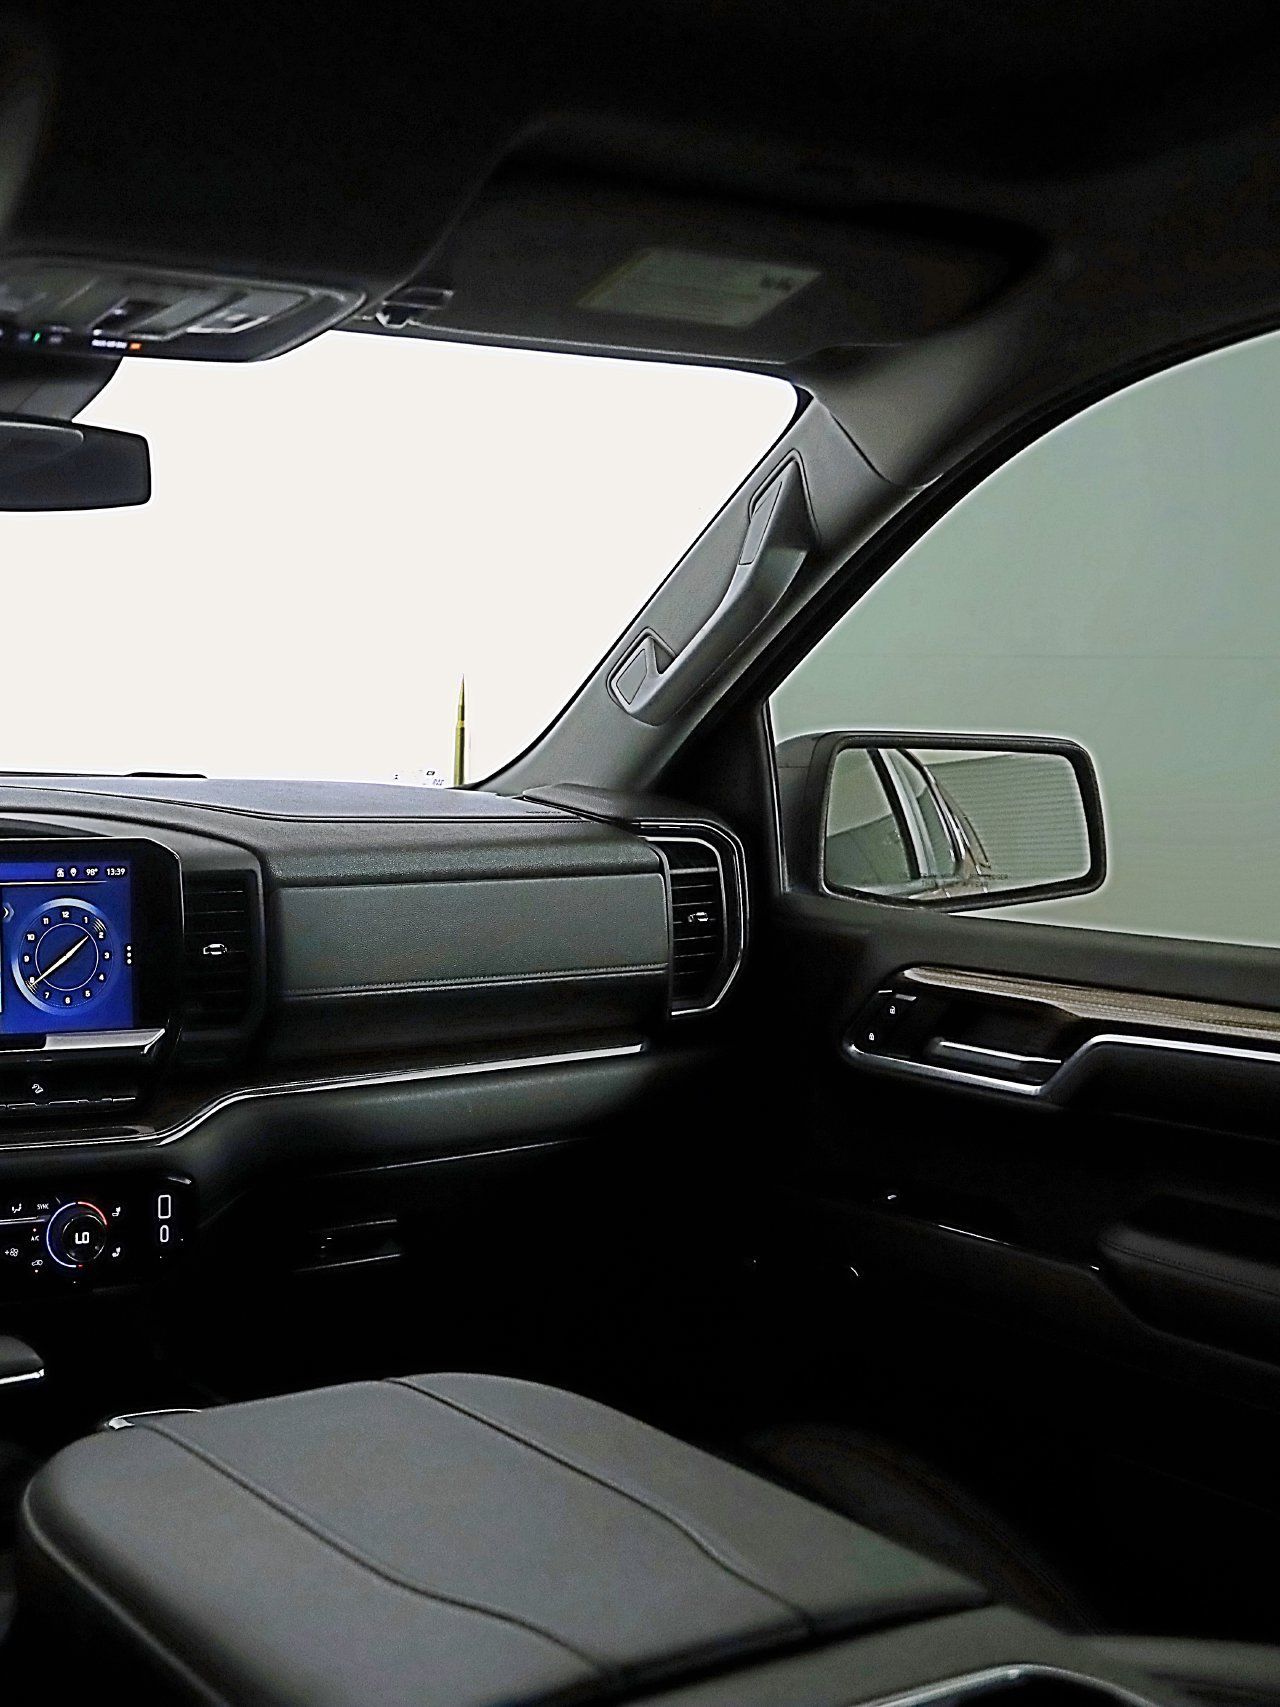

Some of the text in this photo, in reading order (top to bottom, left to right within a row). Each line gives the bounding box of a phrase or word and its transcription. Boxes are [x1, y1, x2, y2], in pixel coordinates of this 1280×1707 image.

[106, 867, 126, 876] 13:39
[42, 917, 49, 925] 11
[26, 933, 35, 941] 10
[23, 955, 30, 963] 9
[44, 991, 50, 999] 7
[85, 990, 91, 998] 5
